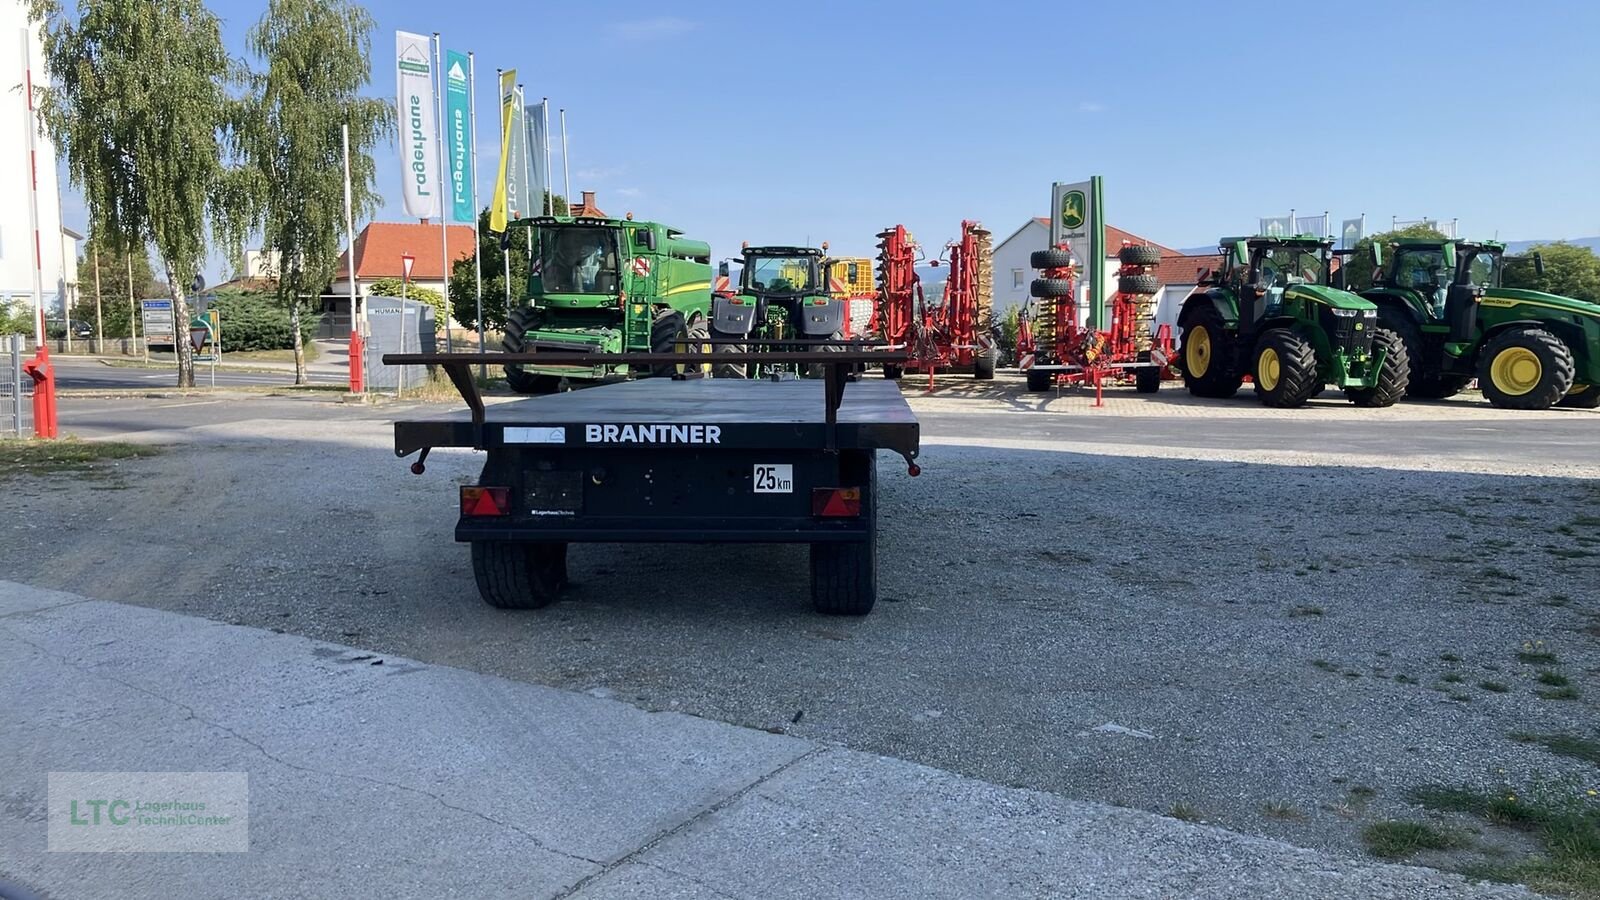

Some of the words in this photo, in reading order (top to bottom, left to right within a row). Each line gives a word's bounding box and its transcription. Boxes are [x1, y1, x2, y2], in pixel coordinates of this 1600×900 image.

[585, 424, 720, 443] BRANTNER
[756, 467, 776, 490] 25
[777, 479, 791, 490] km
